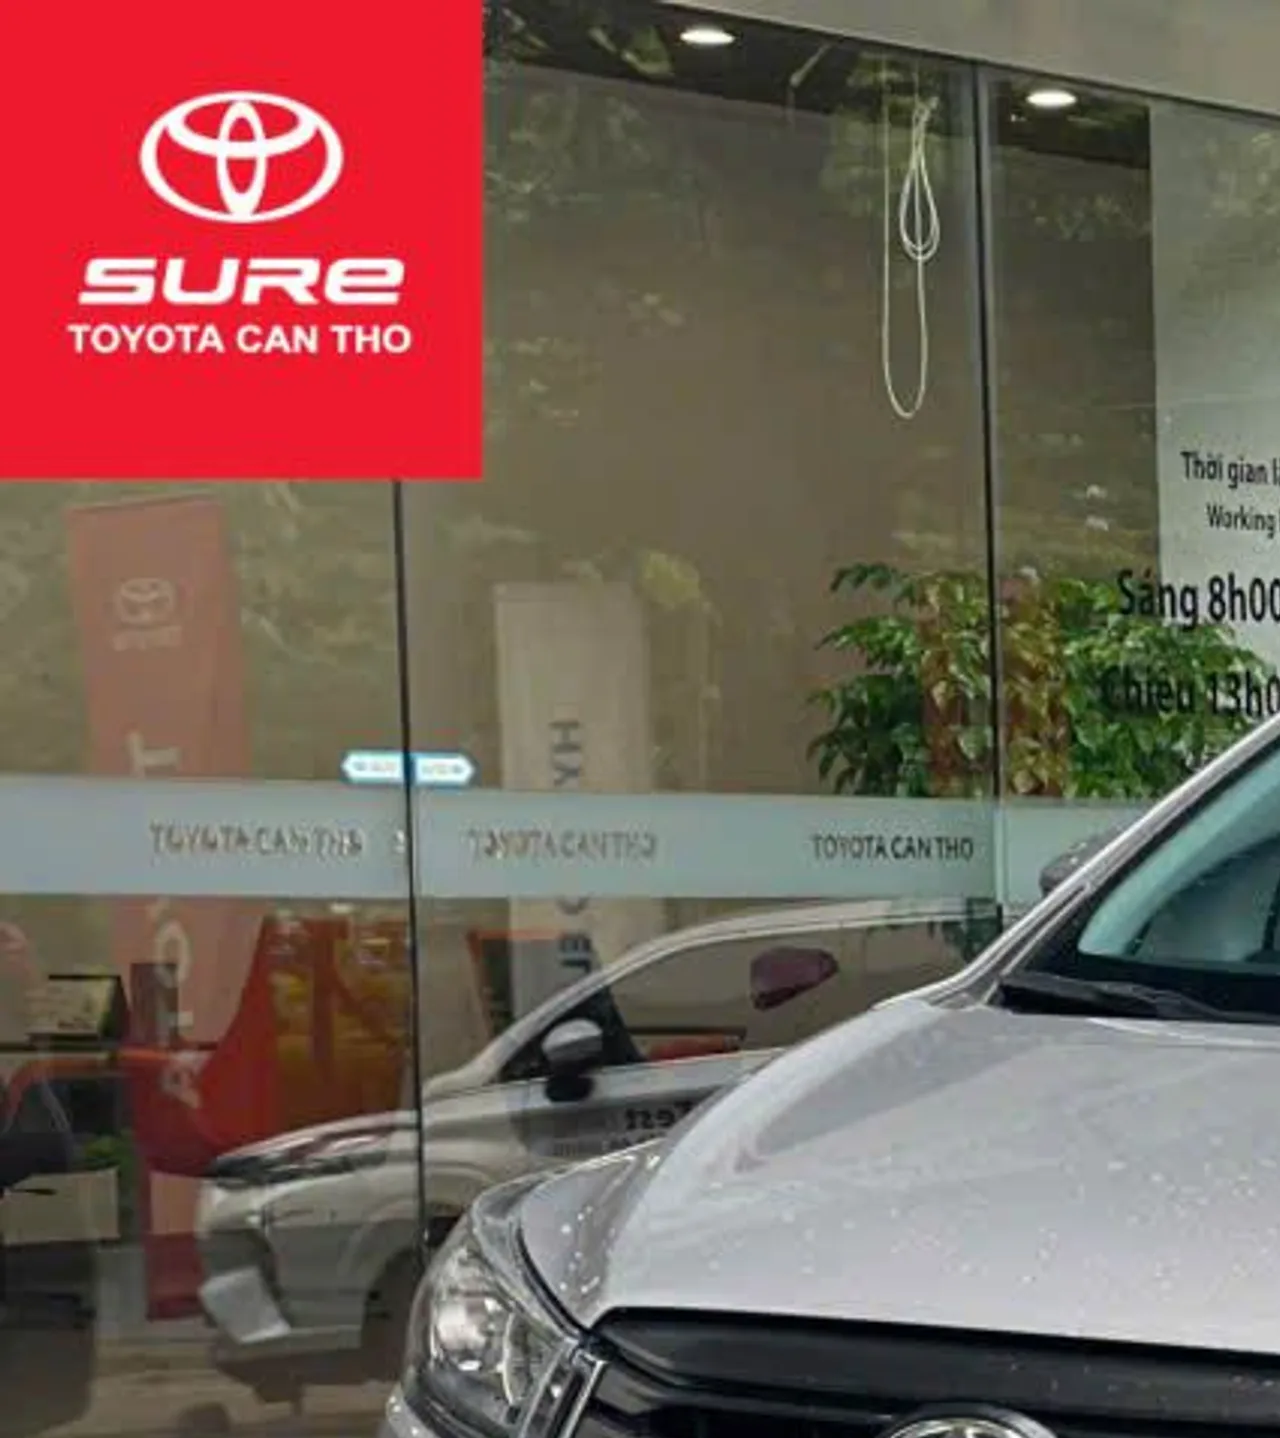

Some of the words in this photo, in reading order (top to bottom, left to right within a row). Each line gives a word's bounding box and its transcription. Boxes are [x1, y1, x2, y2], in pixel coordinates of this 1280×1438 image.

[1180, 450, 1224, 482] Thời
[1227, 456, 1269, 490] gian
[1206, 502, 1274, 540] Working
[1117, 567, 1200, 631] Sáng
[811, 834, 888, 862] TOYOTA
[890, 835, 933, 861] CAN
[934, 836, 975, 863] THO
